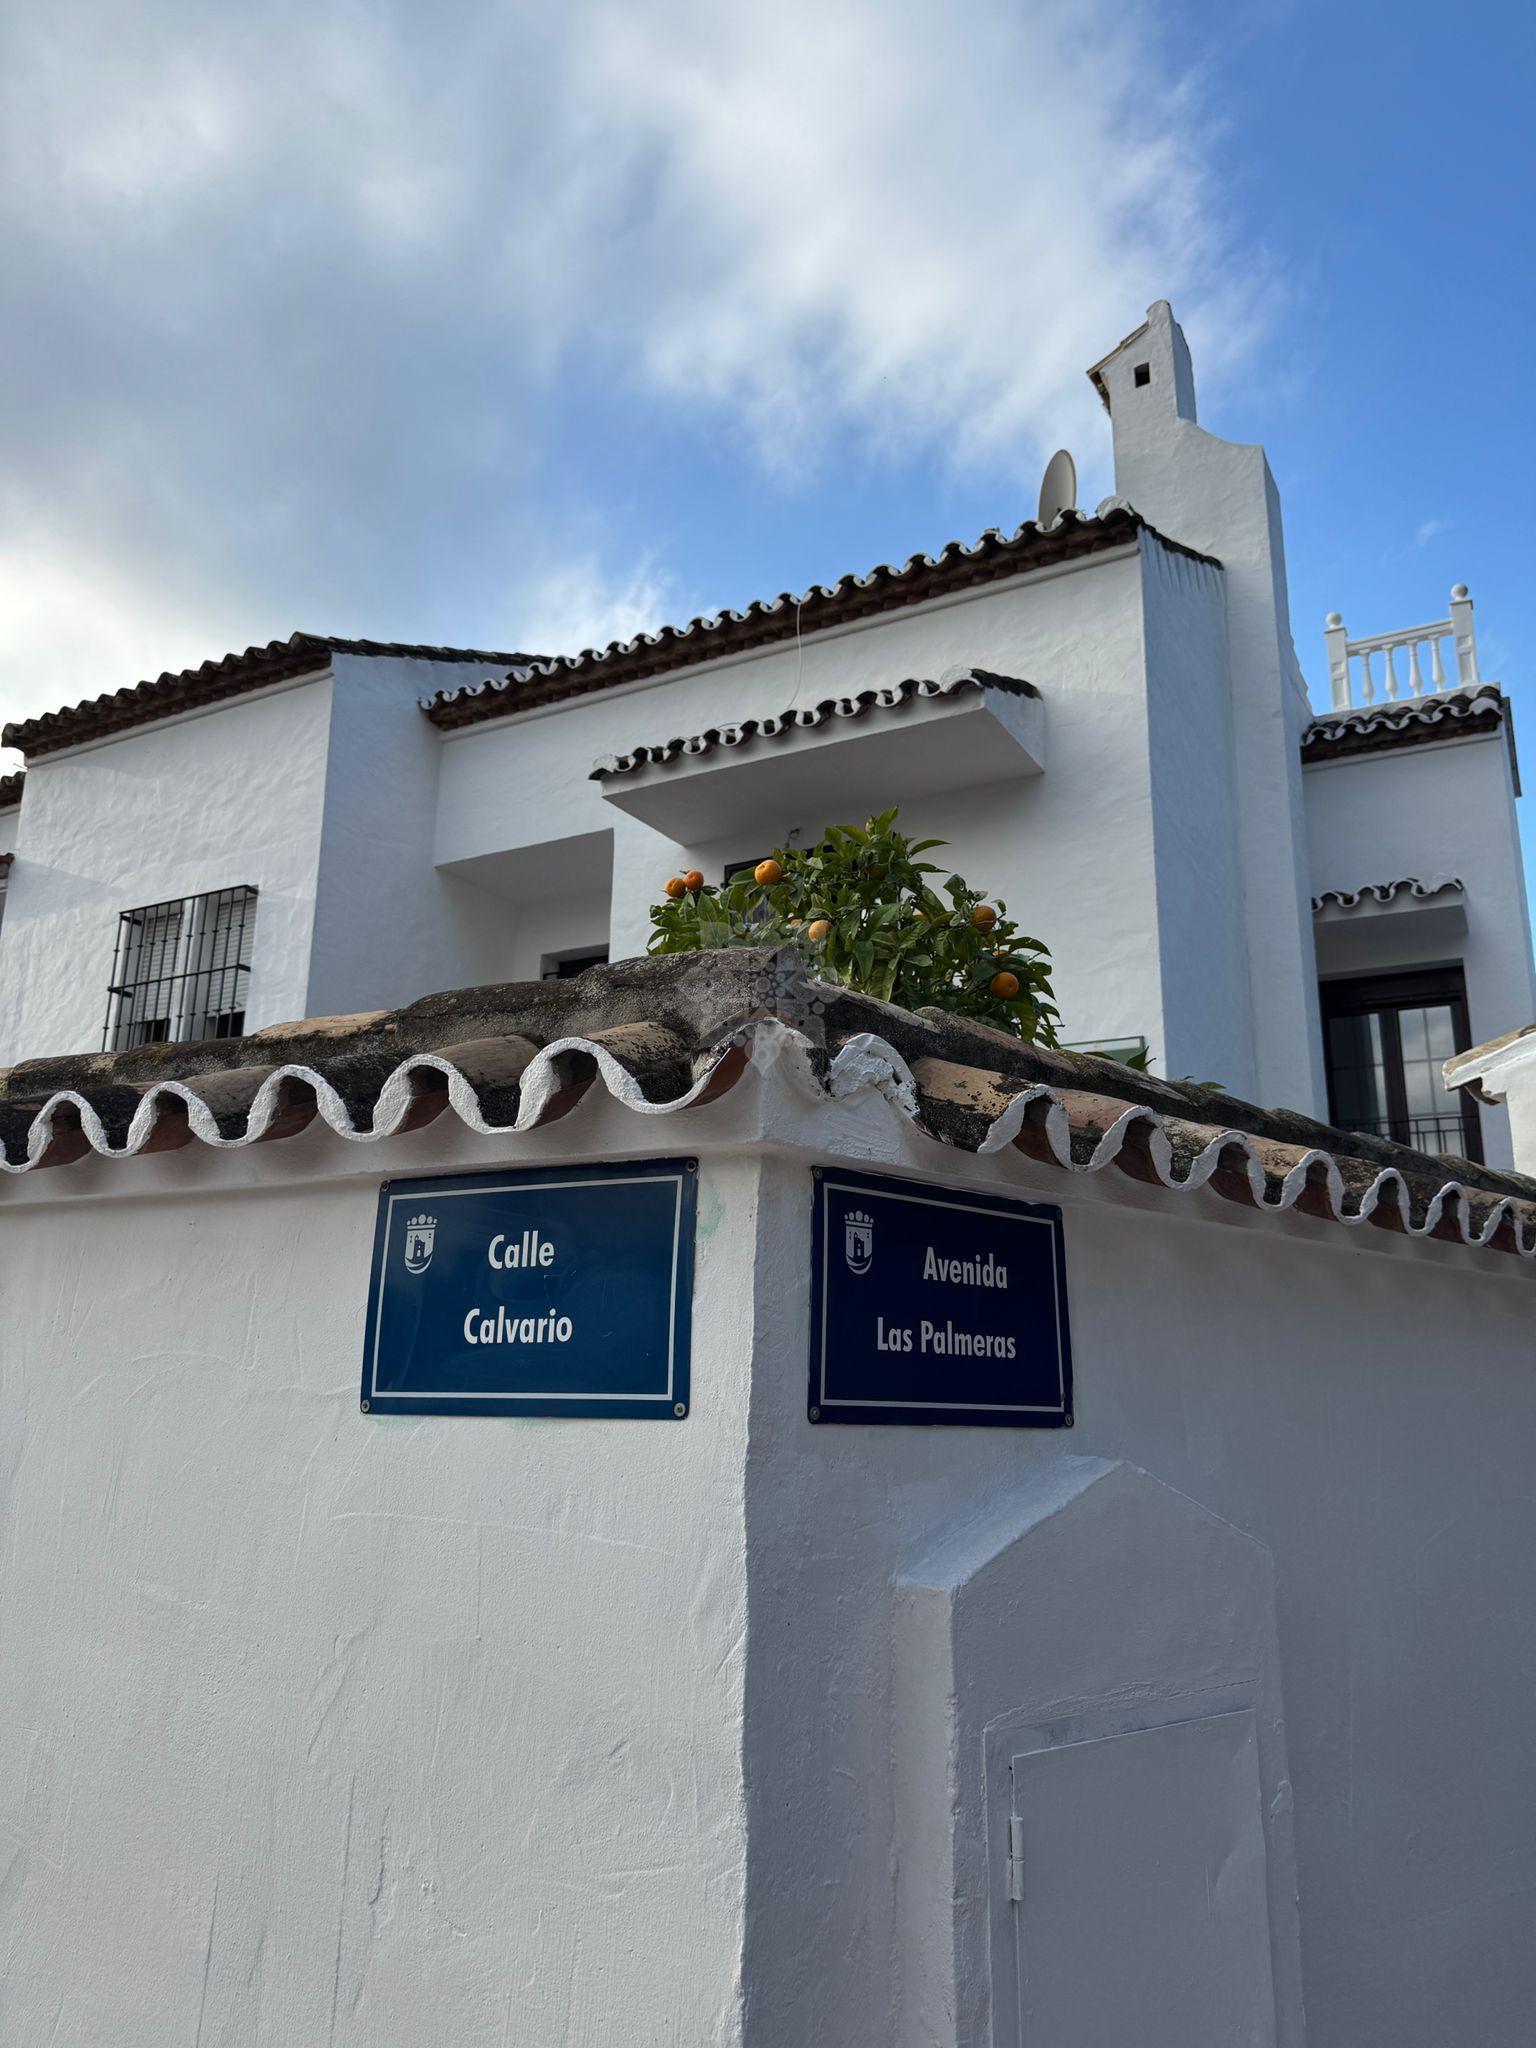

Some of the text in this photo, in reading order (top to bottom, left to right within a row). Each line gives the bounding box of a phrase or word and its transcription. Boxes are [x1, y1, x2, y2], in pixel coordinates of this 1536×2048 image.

[488, 1230, 555, 1270] Calle
[923, 1246, 1008, 1289] Avenida
[463, 1305, 573, 1345] Calvario
[877, 1316, 1016, 1359] Las Palmeras
